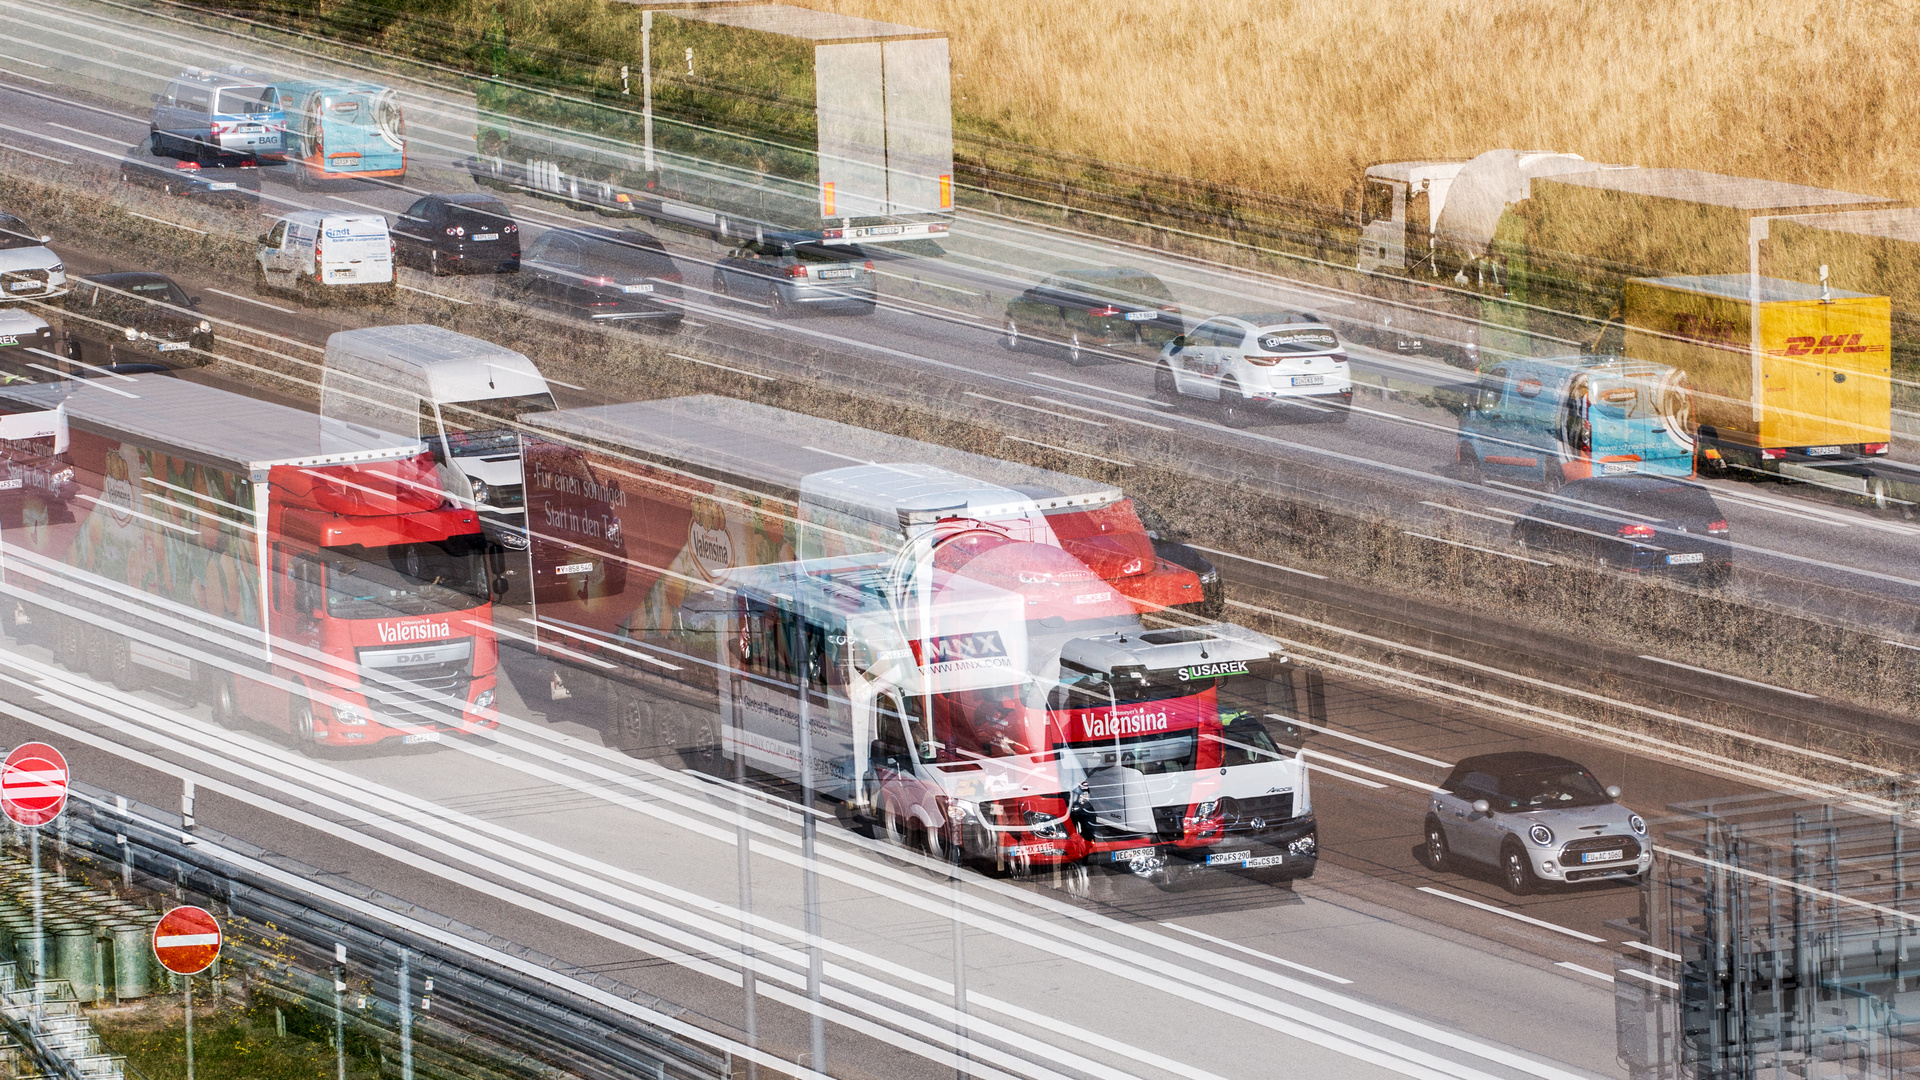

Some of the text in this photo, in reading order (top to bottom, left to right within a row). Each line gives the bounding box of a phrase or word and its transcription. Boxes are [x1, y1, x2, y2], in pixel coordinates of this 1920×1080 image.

[259, 136, 277, 144] BAG
[1784, 333, 1870, 357] DHL
[536, 462, 626, 510] Für einen sonnigen
[545, 500, 567, 529] Start
[569, 508, 579, 532] in
[582, 509, 600, 537] den
[693, 530, 728, 565] Valensina
[377, 618, 450, 643] Valensina
[396, 652, 436, 663] DAF
[924, 634, 1001, 659] MNX
[918, 658, 1012, 676] WWW.MNX.COM
[1178, 660, 1250, 682] SLUSAREK
[1081, 707, 1168, 738] Valensina
[1104, 749, 1151, 763] DAF
